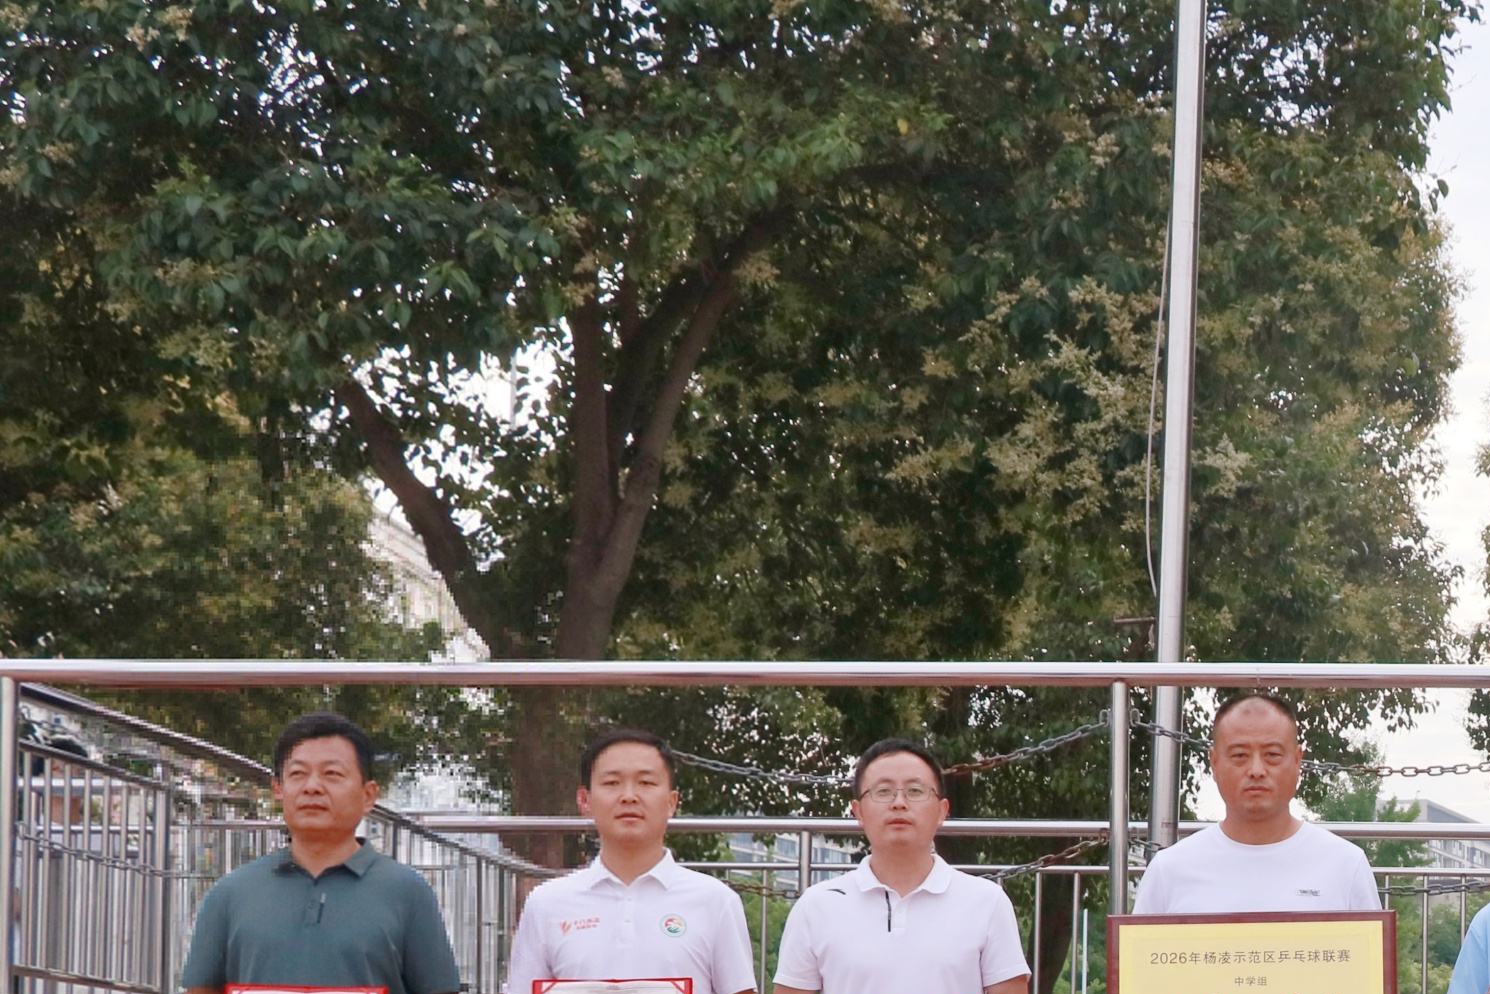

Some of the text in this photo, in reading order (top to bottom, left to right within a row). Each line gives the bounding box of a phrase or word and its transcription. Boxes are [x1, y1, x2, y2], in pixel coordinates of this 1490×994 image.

[1150, 949, 1351, 966] 2026年杨凌示范区乒乓球联赛
[1234, 976, 1268, 987] 中学组
